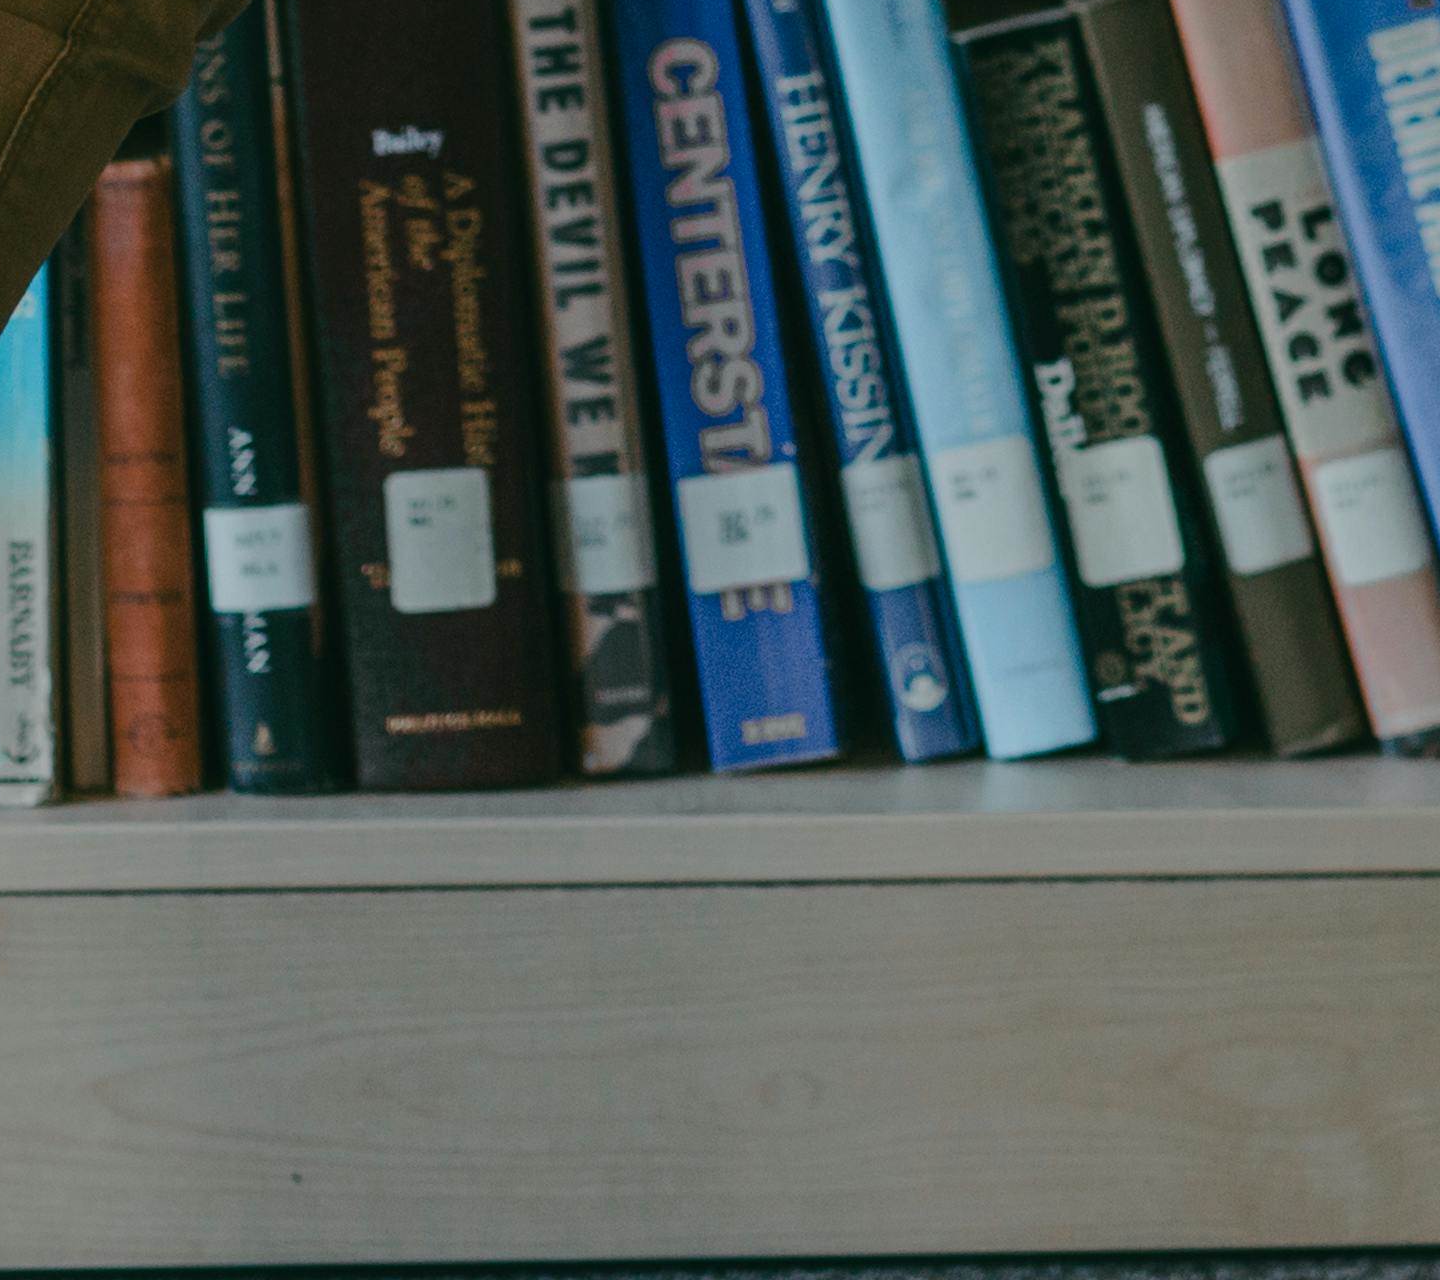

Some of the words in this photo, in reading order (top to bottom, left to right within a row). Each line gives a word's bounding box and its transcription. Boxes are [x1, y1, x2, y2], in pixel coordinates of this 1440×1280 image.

[529, 5, 579, 118] THE
[403, 174, 439, 210] of
[539, 142, 597, 312] DEVIL
[775, 70, 859, 266] HENRY
[361, 180, 403, 312] American
[413, 218, 437, 270] the
[447, 206, 493, 390] Diplomatic
[1251, 199, 1329, 405] PEACE
[1301, 202, 1377, 393] LONG
[373, 322, 417, 458] People
[563, 332, 609, 430] WE
[230, 427, 255, 496] ANN
[9, 540, 34, 692] BARNABY
